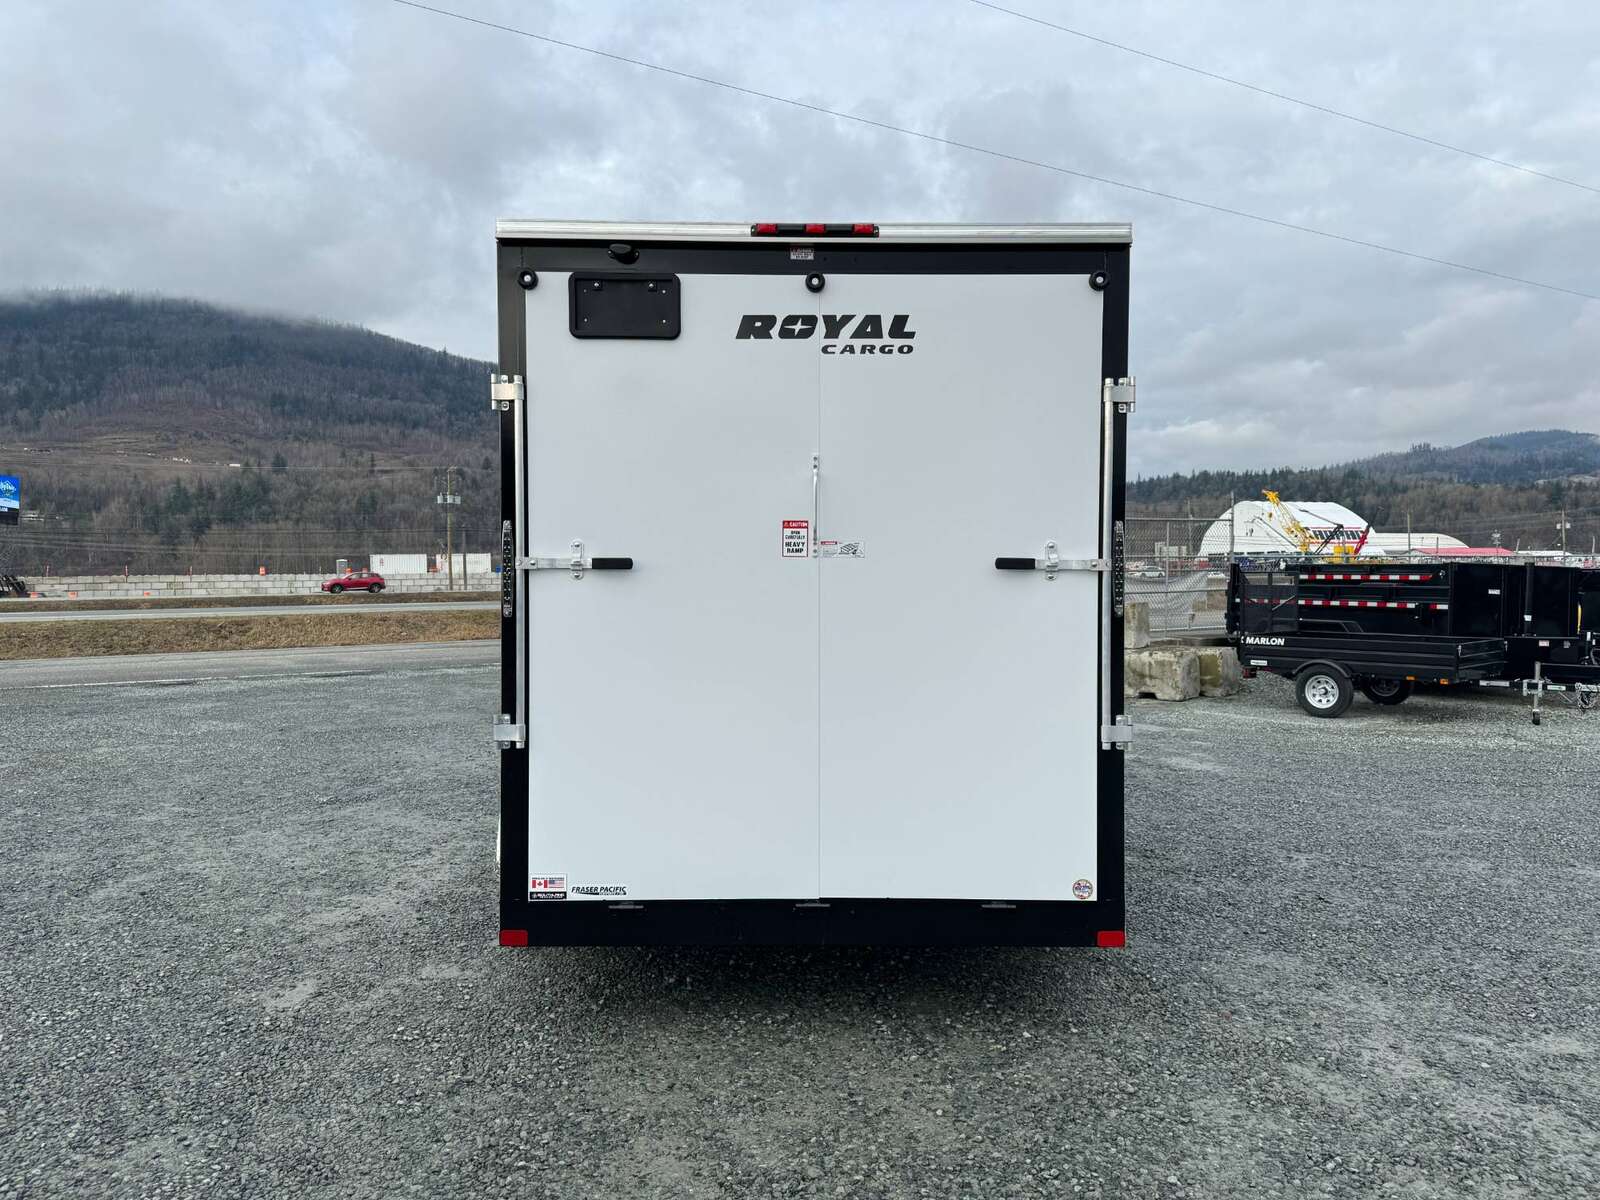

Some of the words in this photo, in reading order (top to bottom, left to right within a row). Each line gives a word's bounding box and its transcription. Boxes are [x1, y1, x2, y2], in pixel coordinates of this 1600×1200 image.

[735, 314, 917, 340] ROYAL
[821, 344, 914, 355] CARGO
[1246, 636, 1285, 646] MARLON
[599, 886, 627, 894] PACIFIC
